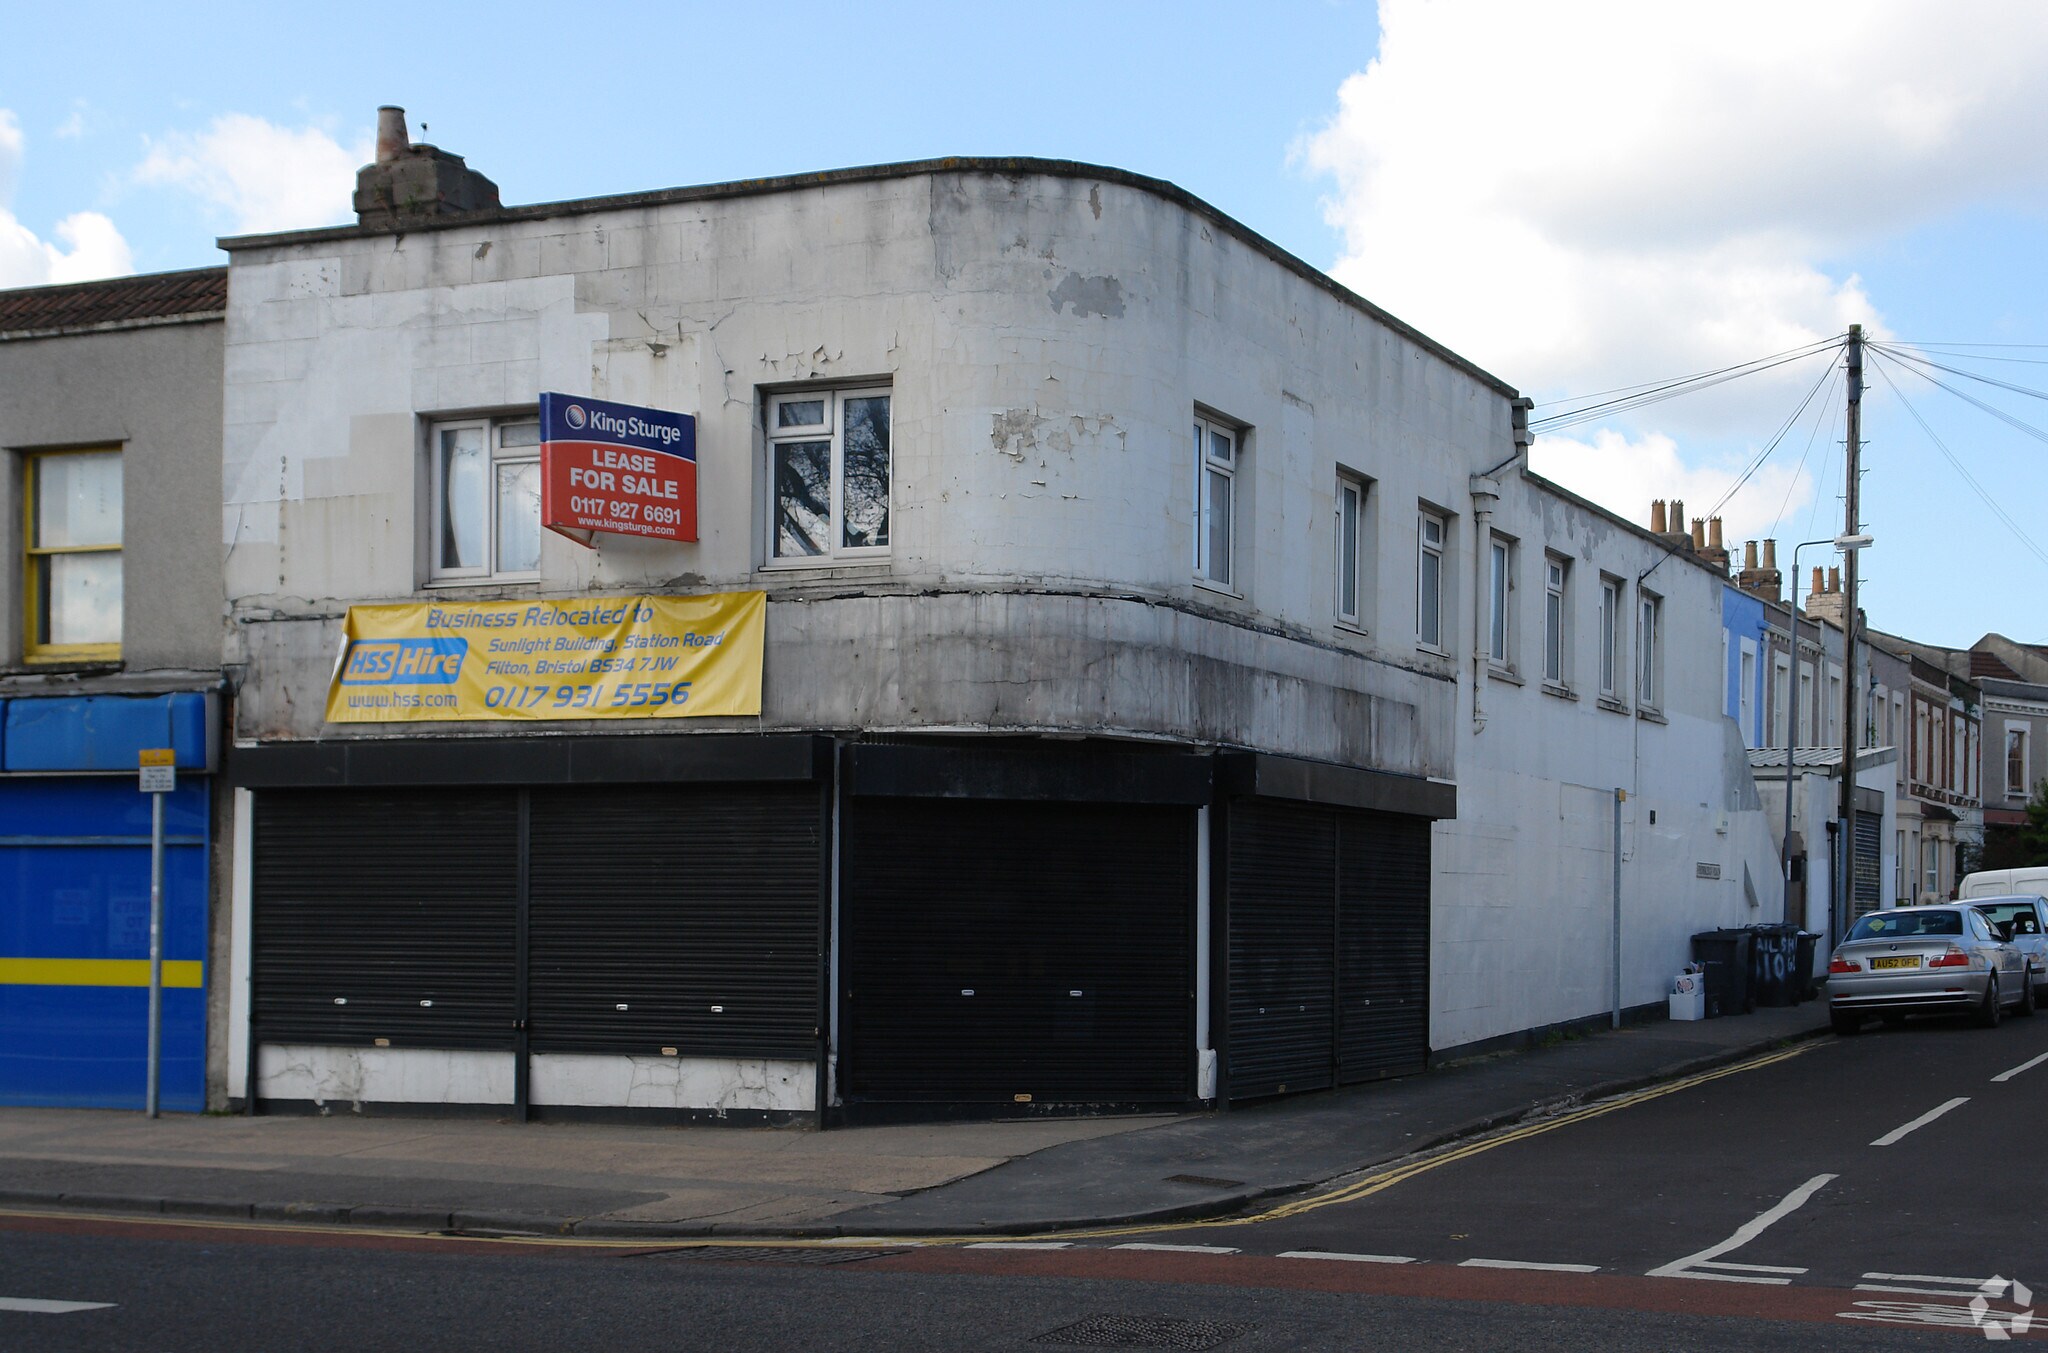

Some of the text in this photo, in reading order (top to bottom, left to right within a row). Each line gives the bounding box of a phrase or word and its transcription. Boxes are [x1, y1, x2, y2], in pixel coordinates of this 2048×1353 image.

[590, 410, 681, 445] King Sturge
[592, 449, 656, 474] LEASE
[570, 467, 678, 499] FOR SALE
[570, 496, 681, 525] 0117 927 6691
[577, 516, 675, 535] www.kingsturge.com
[426, 603, 654, 628] Business Relocated to
[488, 631, 725, 655] Sunlight Building, Station Road
[349, 647, 460, 675] HSS Hire
[485, 656, 680, 676] Filton, Bristol BS34 7JW
[348, 690, 458, 708] www.hss.com
[484, 682, 692, 708] 0117 931 5556
